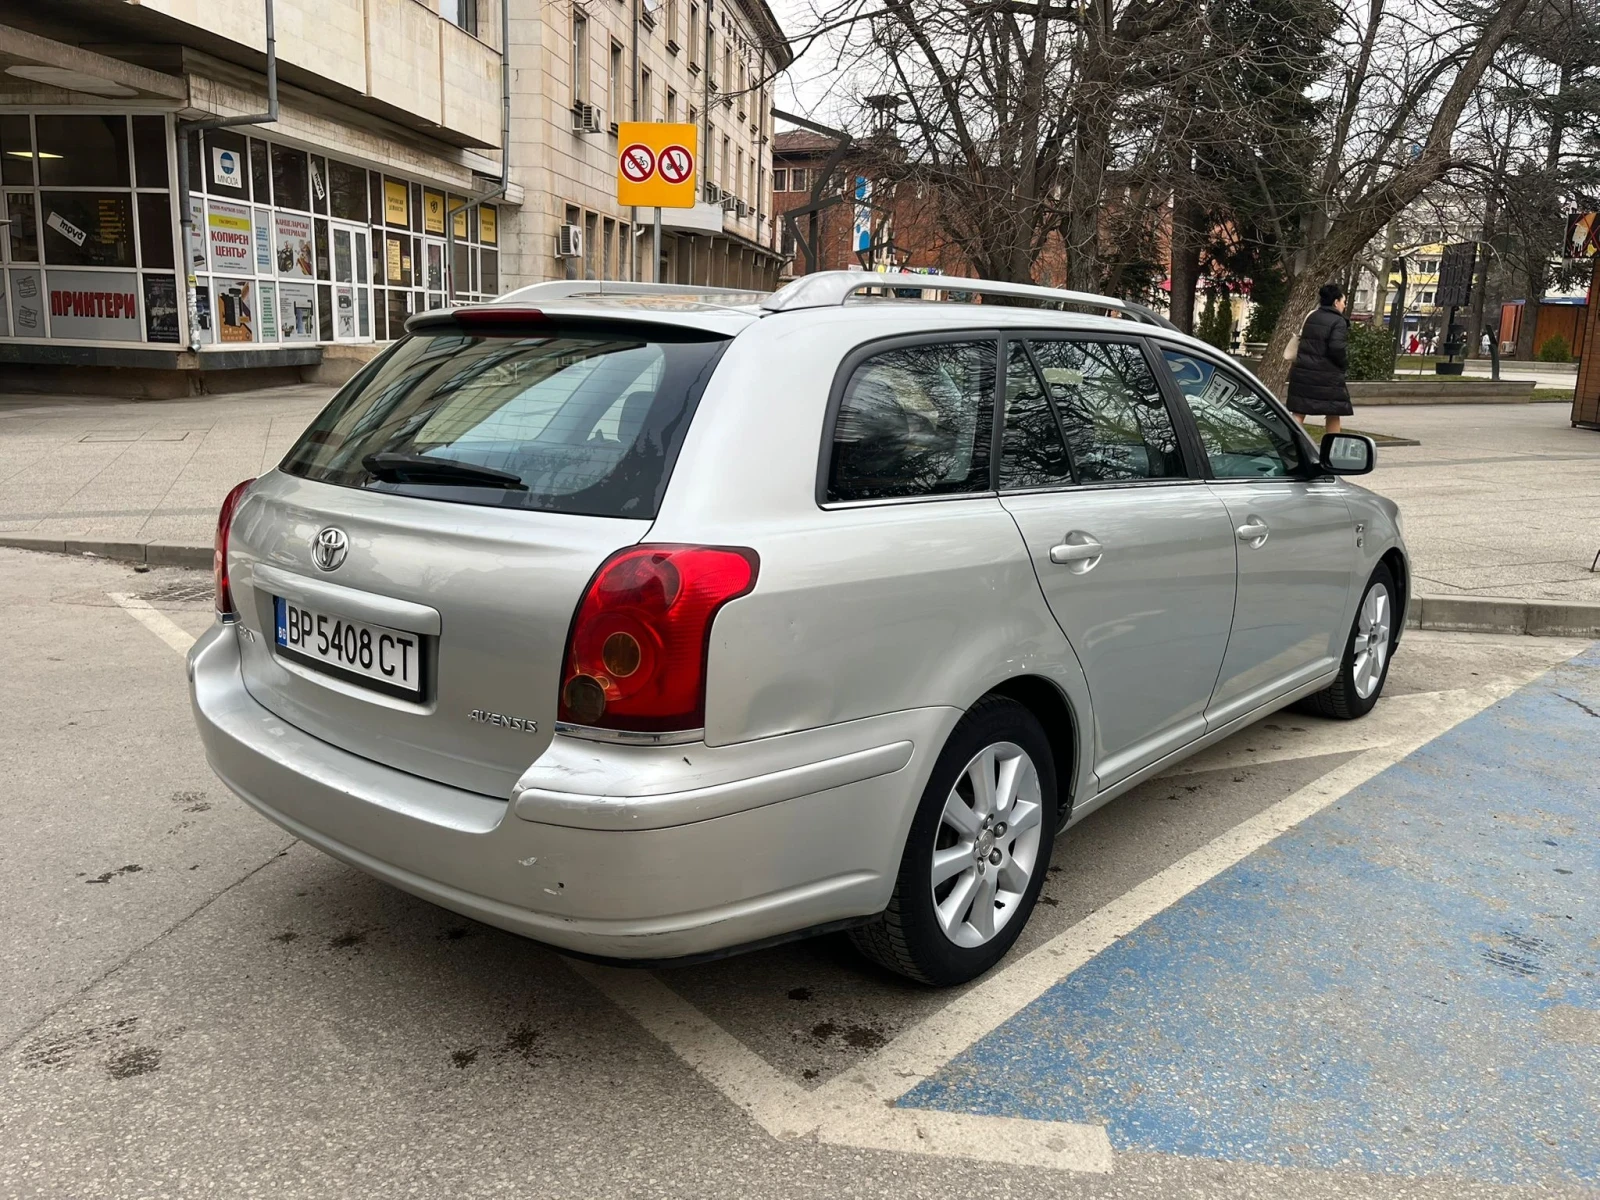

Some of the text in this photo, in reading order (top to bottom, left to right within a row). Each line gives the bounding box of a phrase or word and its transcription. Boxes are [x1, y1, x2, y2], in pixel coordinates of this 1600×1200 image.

[217, 174, 239, 186] MINOLTA
[211, 230, 249, 245] КОПИРЕН
[215, 245, 247, 259] ЦЕНТЪР
[50, 290, 136, 320] ПРИНТЕРИ
[288, 605, 413, 681] BP 5408 CT
[468, 709, 538, 733] AVENSIS
